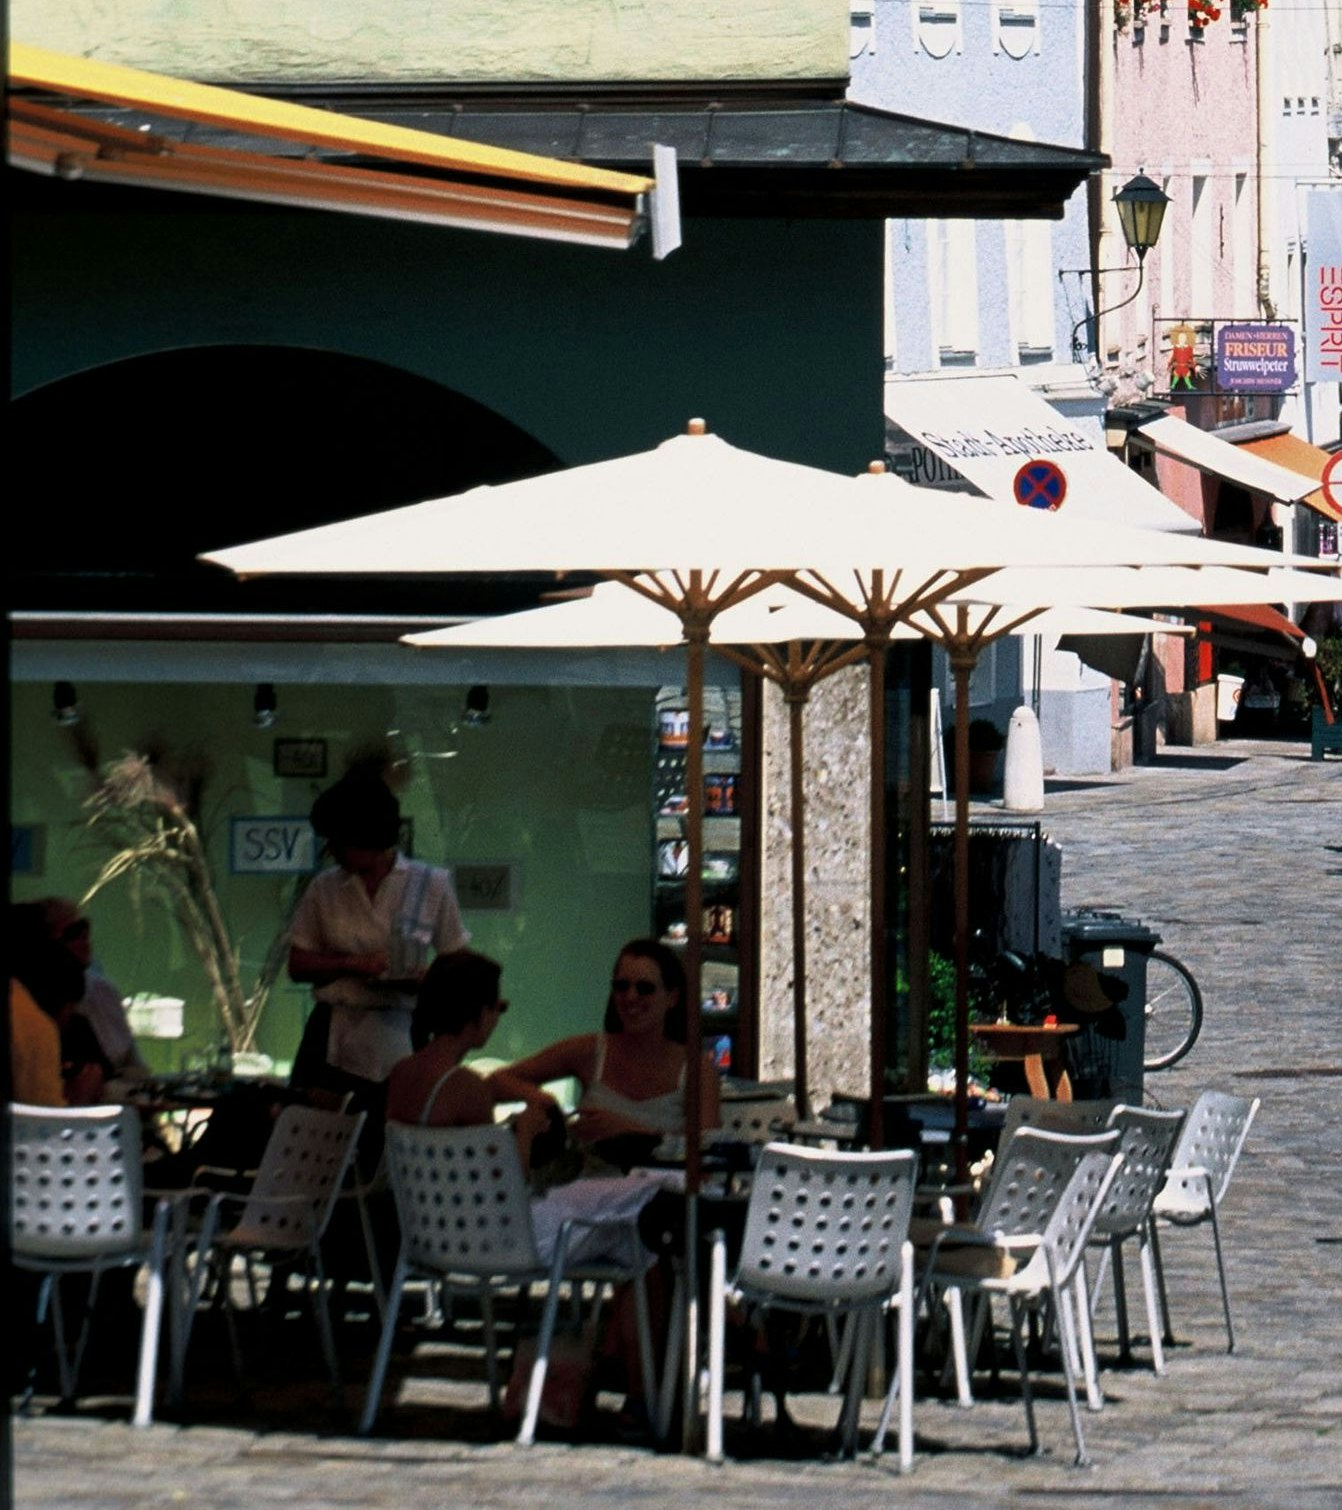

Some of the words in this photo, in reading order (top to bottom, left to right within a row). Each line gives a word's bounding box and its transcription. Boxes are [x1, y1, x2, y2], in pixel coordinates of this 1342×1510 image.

[1224, 342, 1289, 358] FRISEUR
[1223, 357, 1289, 376] Struwwelpeter
[244, 826, 300, 862] SSV
